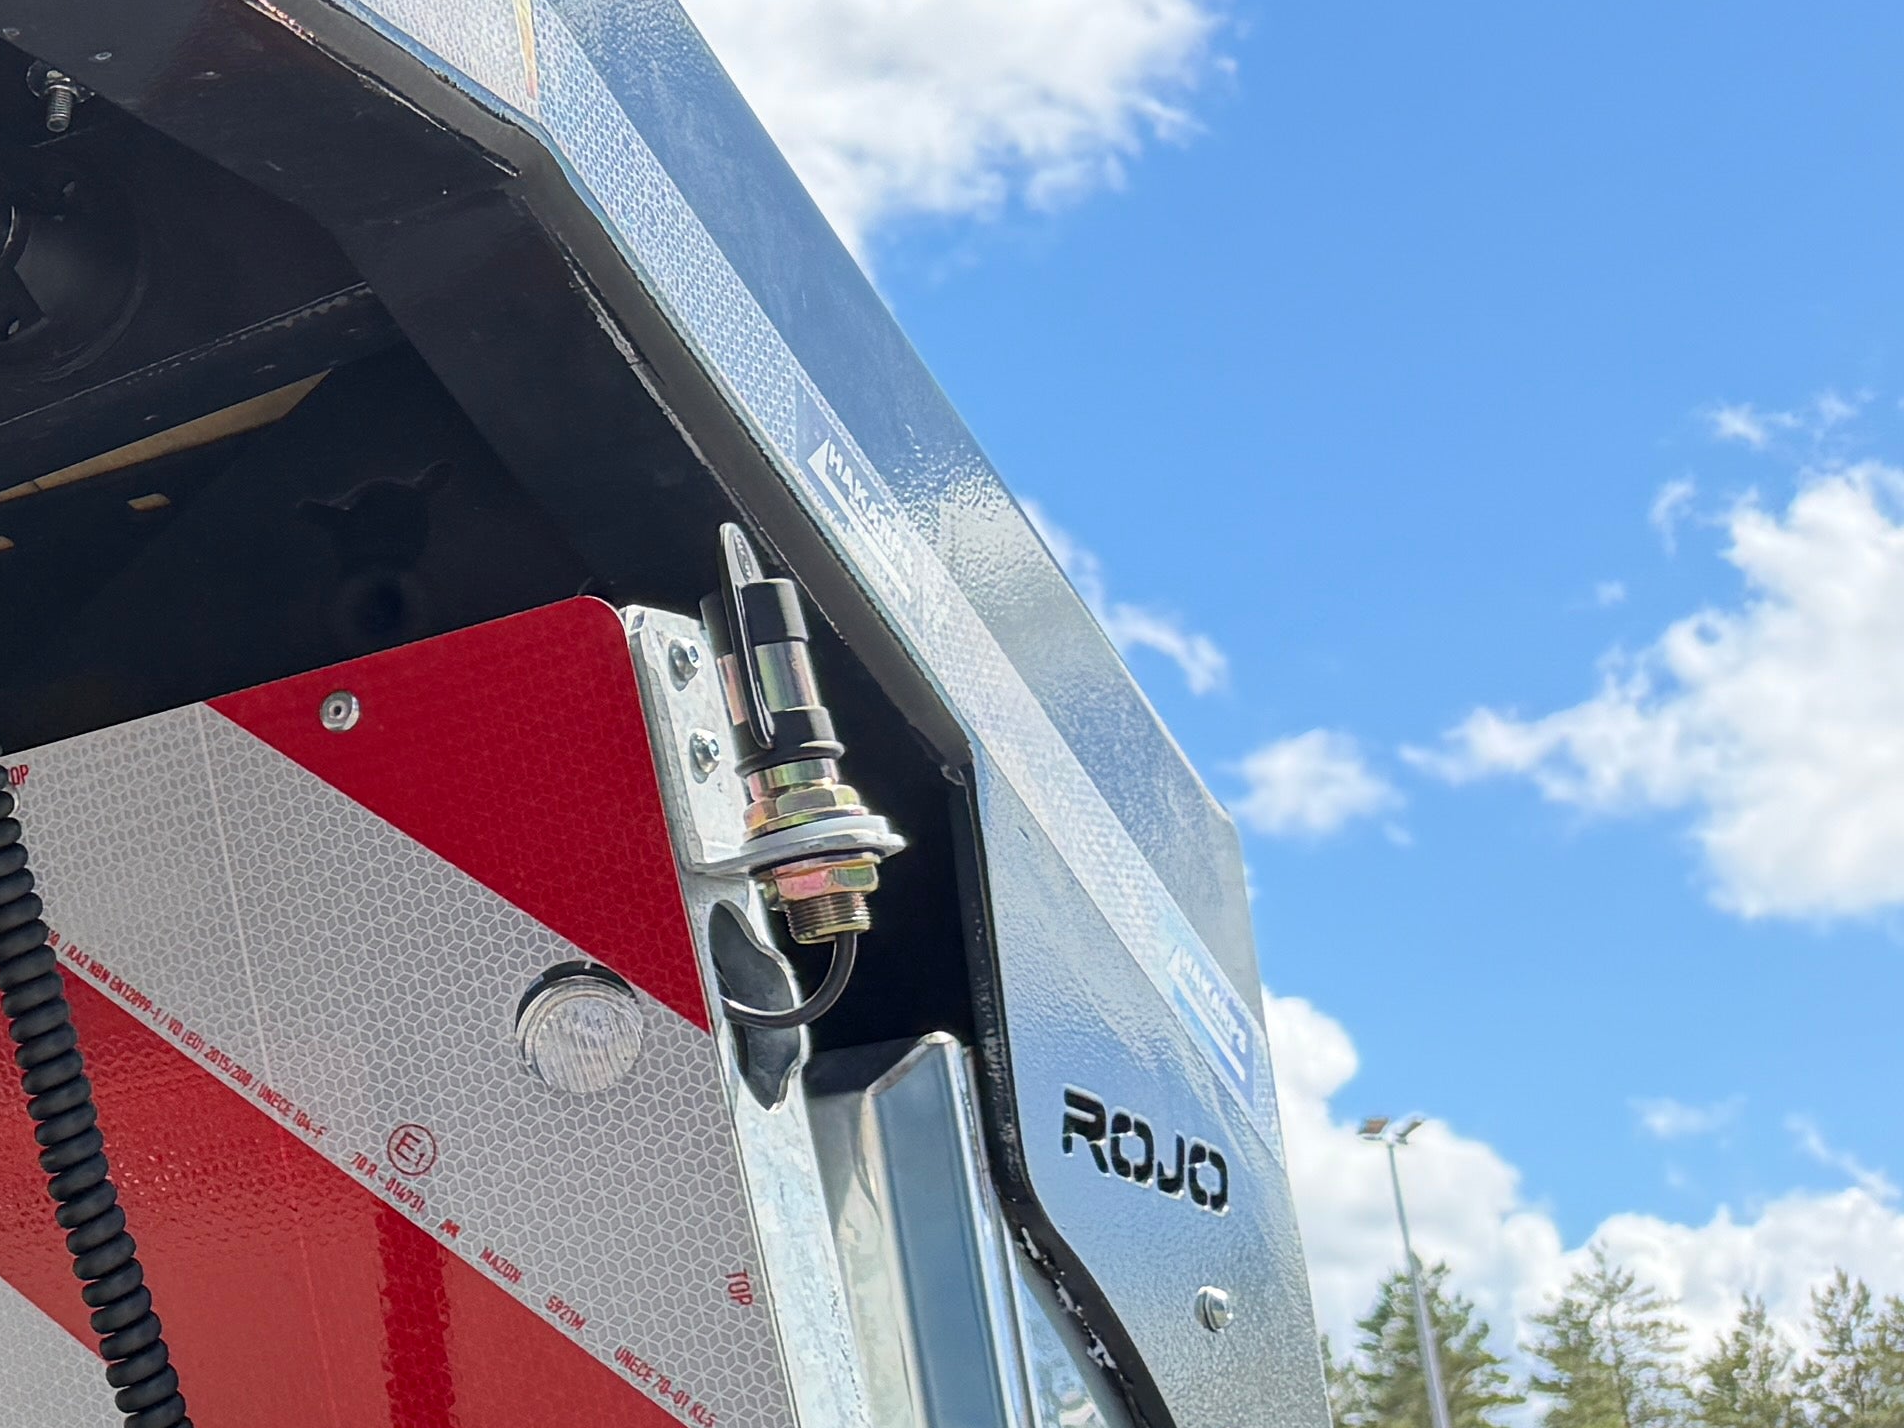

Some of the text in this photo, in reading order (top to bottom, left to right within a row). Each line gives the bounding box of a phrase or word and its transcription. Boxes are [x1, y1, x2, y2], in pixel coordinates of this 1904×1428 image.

[7, 764, 30, 786] OP
[65, 944, 90, 968] RA2
[257, 1082, 295, 1118] UNECE
[292, 1108, 328, 1139] 104-F
[1061, 1084, 1230, 1217] ROJO
[478, 1245, 523, 1284] MAZON
[724, 1268, 754, 1307] TOP
[544, 1294, 588, 1332] 5921M
[613, 1344, 655, 1383] UNECE
[652, 1373, 691, 1410] 70-01
